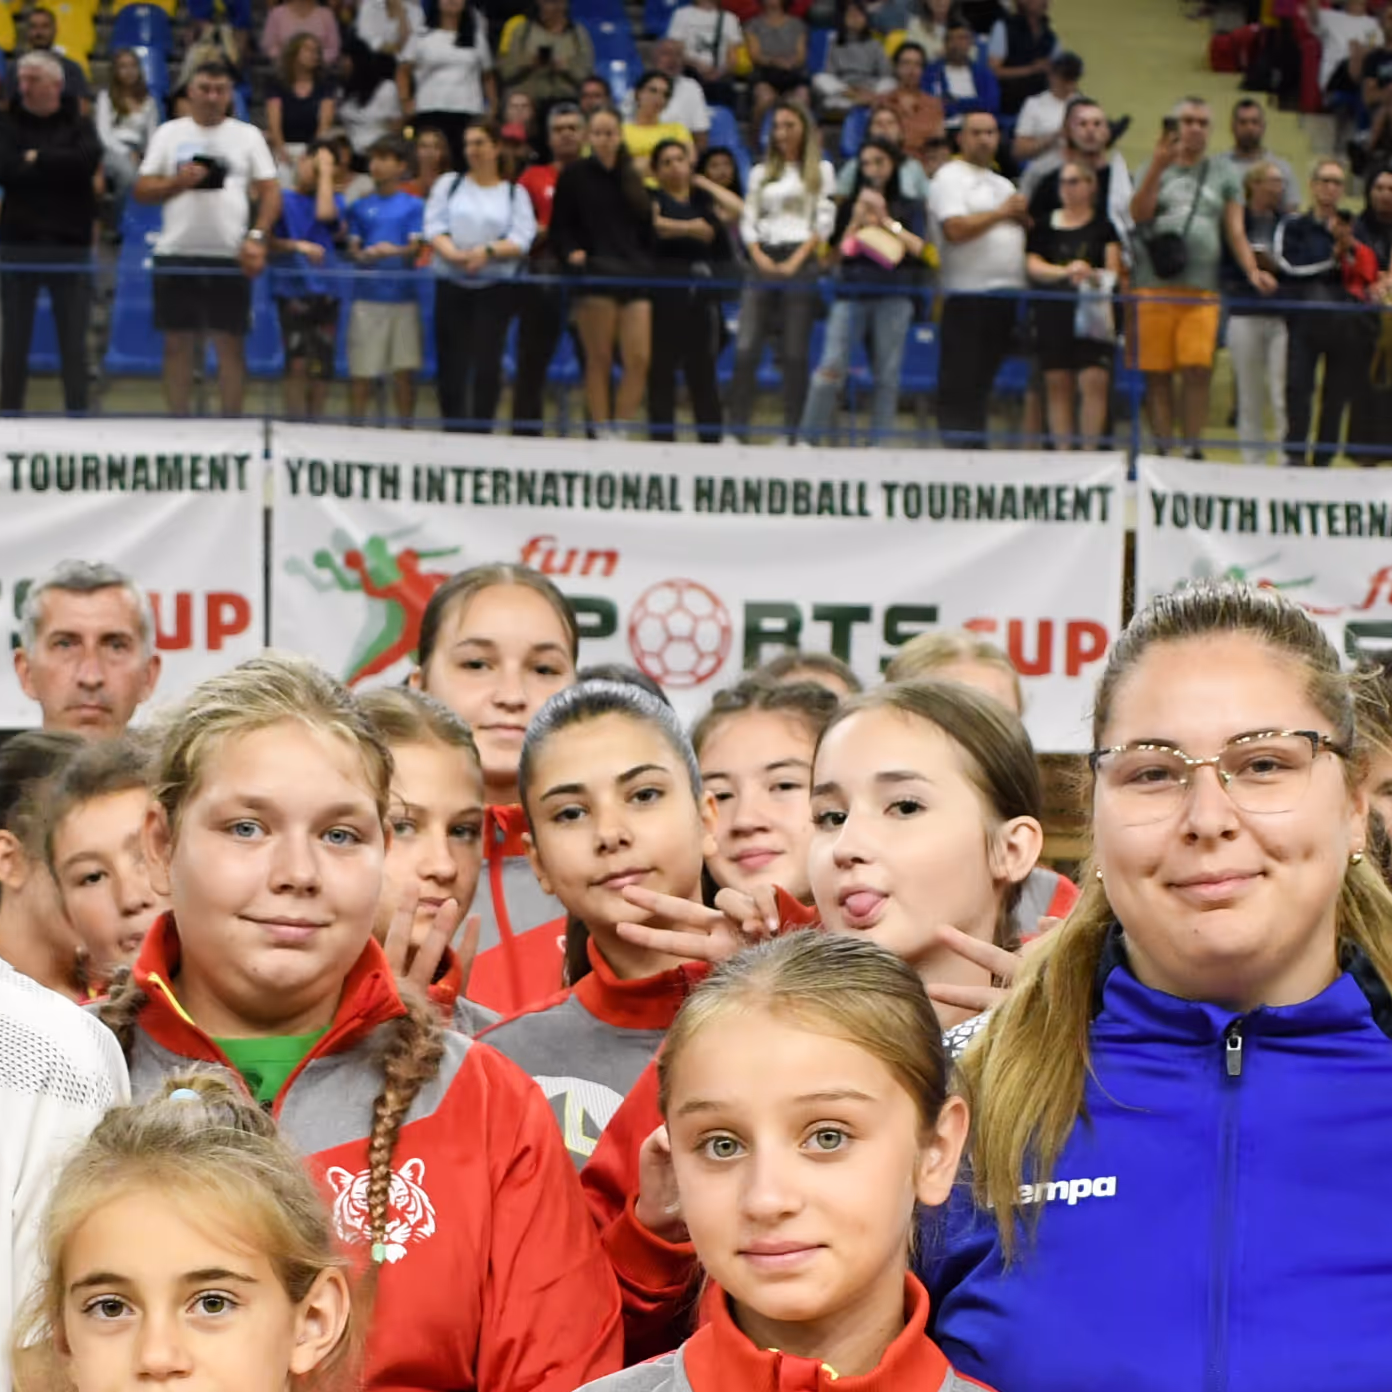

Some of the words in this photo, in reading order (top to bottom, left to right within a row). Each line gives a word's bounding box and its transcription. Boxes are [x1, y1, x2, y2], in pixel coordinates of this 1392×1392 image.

[8, 454, 252, 492] TOURNAMENT
[285, 457, 399, 500] YOUTH
[412, 464, 682, 511] INTERNATIONAL
[694, 475, 871, 517] HANDBALL
[882, 481, 1114, 523] TOURNAMENT
[1149, 490, 1259, 533] YOUTH
[520, 535, 619, 578] fun
[148, 592, 252, 651] UP
[986, 1176, 1117, 1208] empa
